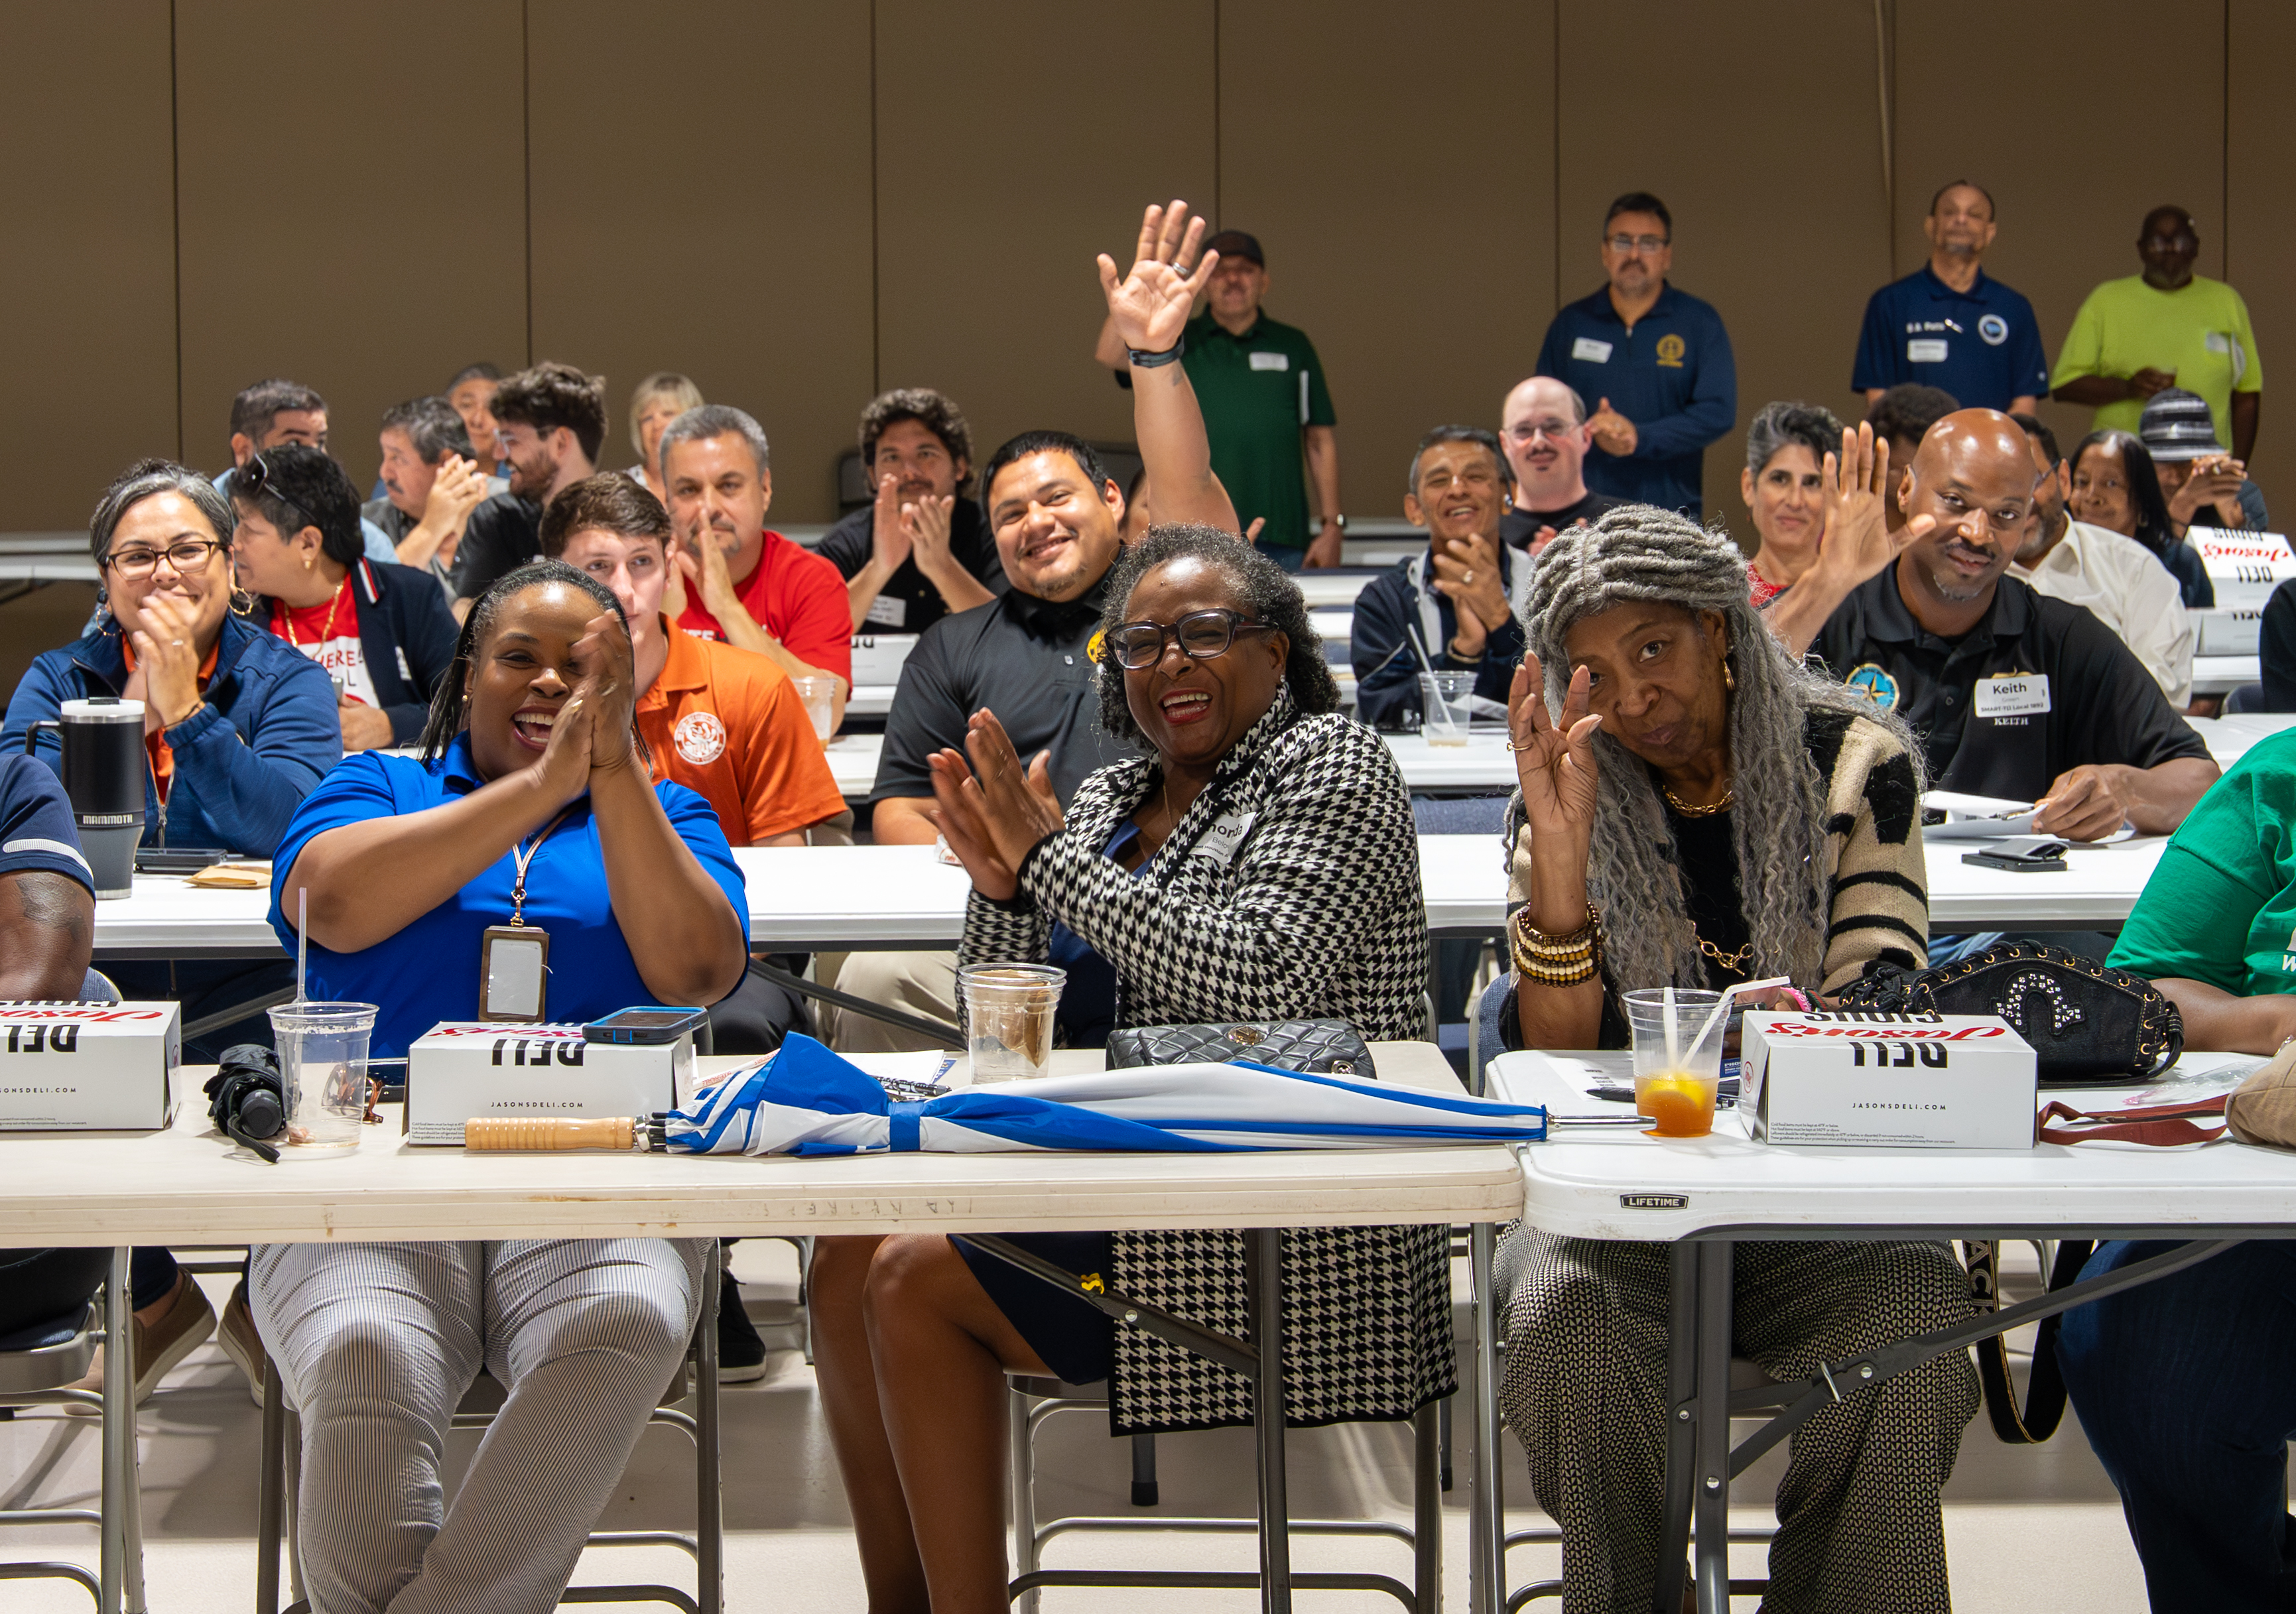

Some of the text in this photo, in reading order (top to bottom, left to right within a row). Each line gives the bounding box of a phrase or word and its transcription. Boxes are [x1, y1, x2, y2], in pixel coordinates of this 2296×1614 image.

[1993, 682, 2027, 694] Keith
[1994, 717, 2029, 725] KEITH
[82, 814, 133, 824] MAMMOTH
[1204, 845, 1224, 856] Houston
[1764, 1023, 2006, 1041] Jason's
[491, 1038, 588, 1066] DELI
[1848, 1041, 1948, 1069] DELI
[1629, 1197, 1679, 1206] LIFETIME
